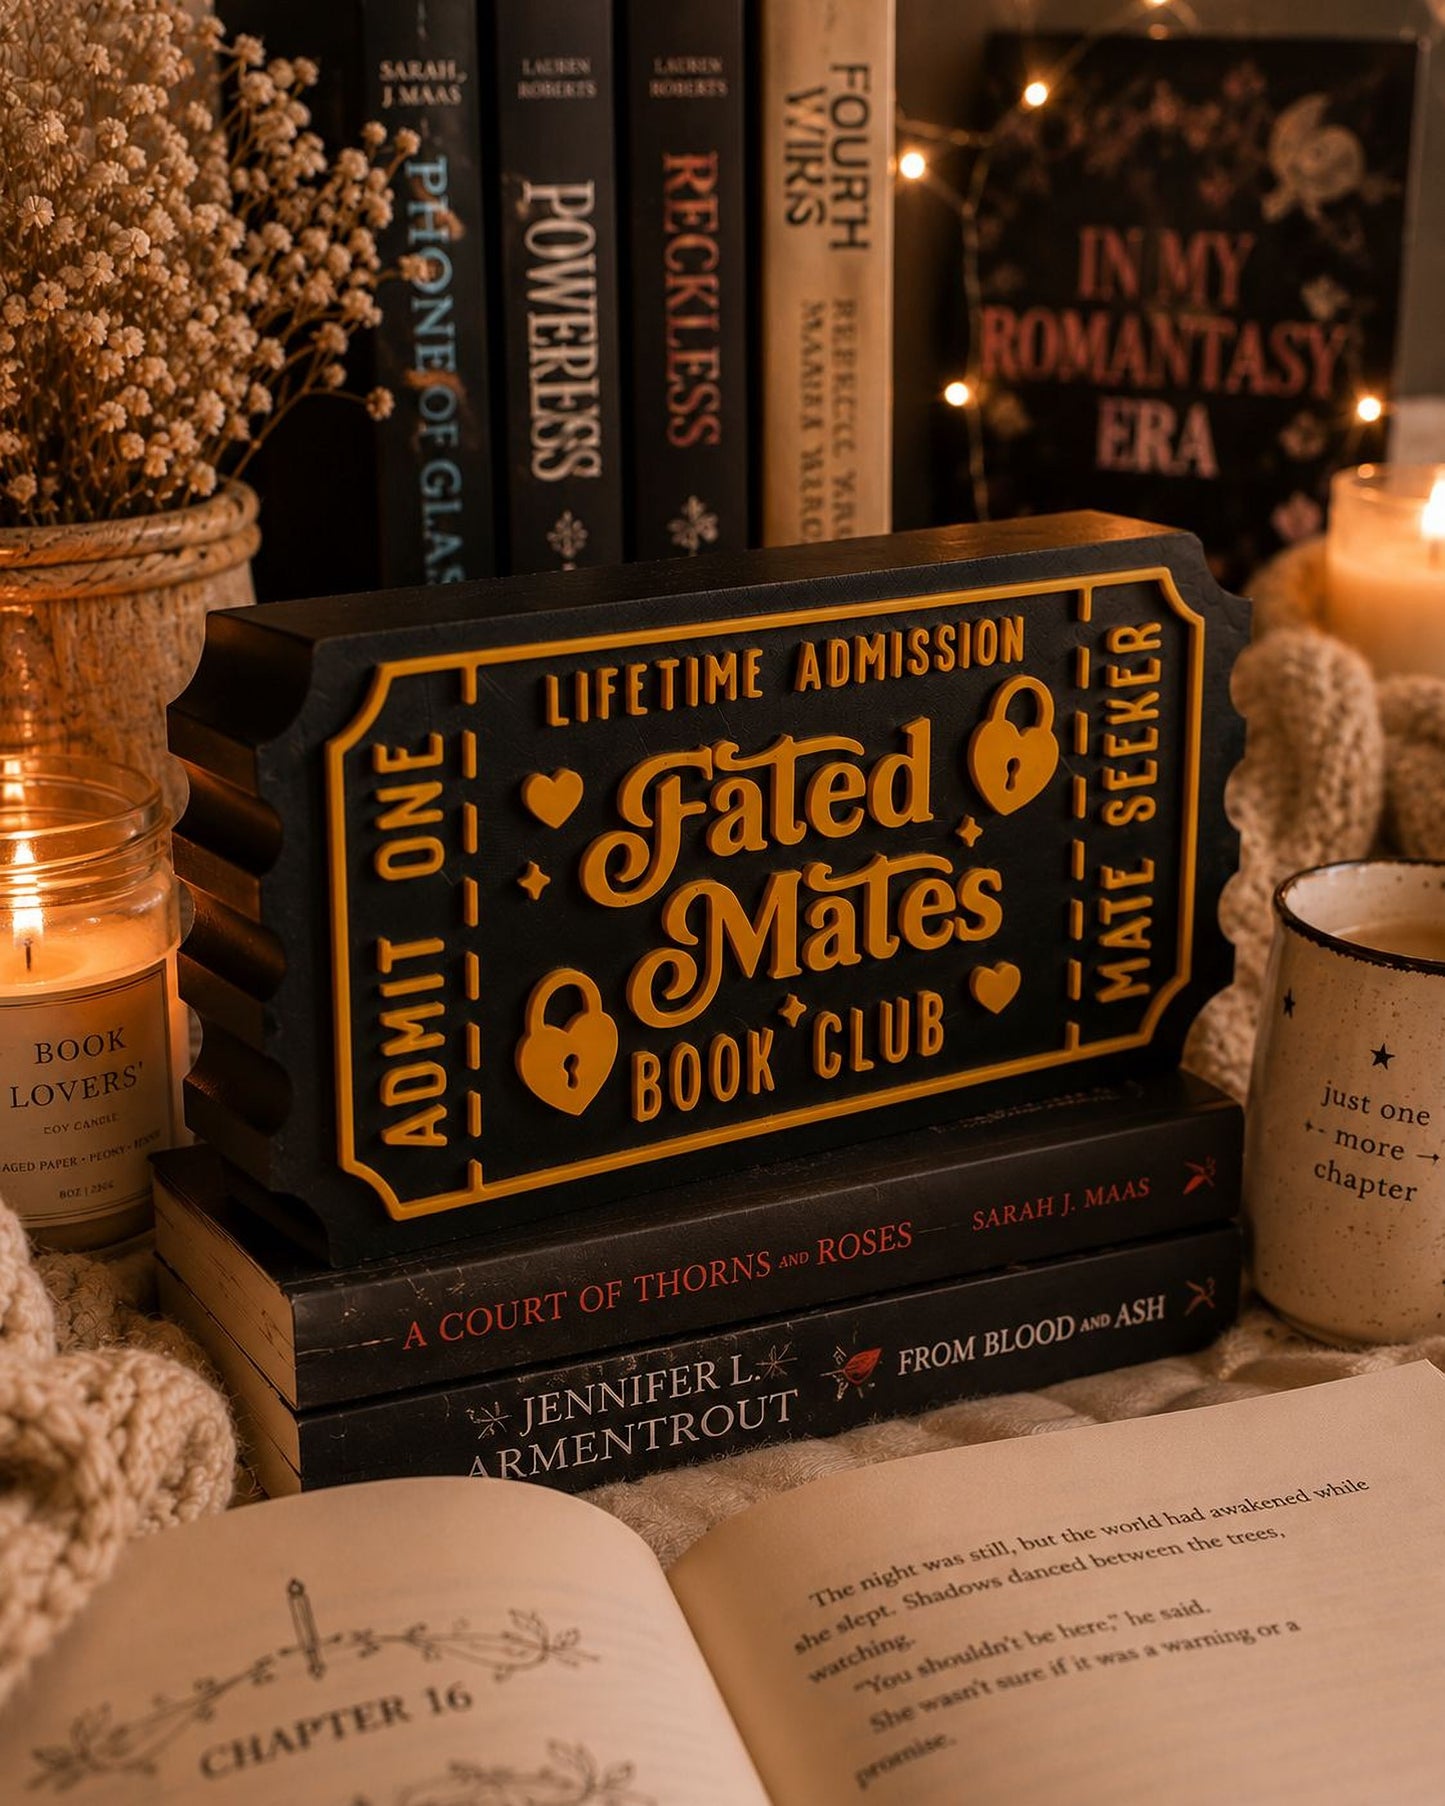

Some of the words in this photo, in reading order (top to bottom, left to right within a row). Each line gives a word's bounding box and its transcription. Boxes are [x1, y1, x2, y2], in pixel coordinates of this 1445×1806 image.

[829, 63, 871, 251] FOURTH
[663, 150, 721, 448] RECKLESS
[1078, 226, 1144, 299] IN
[1157, 231, 1257, 307] MY
[981, 305, 1348, 398] ROMANTASY
[418, 386, 459, 448] OF
[1098, 401, 1220, 478] ERA
[546, 648, 764, 727] LIFETIME
[795, 616, 1024, 692] ADMISSION
[1102, 621, 1162, 826] SEEKER
[372, 731, 444, 882] ONE
[579, 716, 934, 908] Fated
[627, 853, 1003, 1029] Mates
[1096, 858, 1154, 1003] MATE
[10, 1061, 144, 1109] LOVERS'
[35, 1027, 127, 1065] BOOK
[377, 937, 448, 1147] ADMIT
[631, 1027, 775, 1122] BOOK
[813, 990, 944, 1079] CLUB
[1321, 1080, 1371, 1114] just
[1380, 1103, 1430, 1126] one
[1335, 1128, 1405, 1160] more
[2, 1161, 35, 1172] AGED
[40, 1157, 77, 1171] PAPER
[972, 1196, 1054, 1231] SARAH
[1062, 1192, 1076, 1216] J.
[1084, 1177, 1151, 1208] MAAS
[1314, 1160, 1418, 1202] chapter
[402, 1320, 427, 1350] A
[439, 1291, 568, 1343] COURT
[579, 1279, 624, 1313] OF
[634, 1251, 771, 1304] THORNS
[778, 1249, 809, 1269] AND
[816, 1221, 913, 1265] ROSES
[898, 1335, 975, 1375] FROM
[983, 1315, 1075, 1359] BLOOD
[1079, 1313, 1110, 1333] AND
[1114, 1295, 1165, 1329] ASH
[468, 1388, 799, 1481] ARMENTROUT
[520, 1359, 720, 1436] JENNIFER
[730, 1353, 762, 1386] L.
[793, 1627, 832, 1655] she
[836, 1604, 897, 1635] slept.
[901, 1574, 1003, 1611] Shadows
[1007, 1554, 1088, 1585] danced
[1089, 1543, 1184, 1569] between
[1187, 1533, 1223, 1552] the
[1225, 1525, 1286, 1545] trees,
[808, 1582, 856, 1609] The
[860, 1565, 918, 1588] night
[922, 1552, 965, 1572] was
[969, 1540, 1017, 1563] still,
[1017, 1533, 1059, 1552] but
[1061, 1524, 1097, 1544] the
[1100, 1514, 1163, 1536] world
[1162, 1507, 1206, 1527] had
[1209, 1488, 1312, 1519] awakened
[1312, 1478, 1370, 1501] while
[807, 1633, 916, 1684] watching.
[869, 1704, 916, 1733] She
[918, 1676, 993, 1714] wasn't
[995, 1666, 1047, 1691] sure
[1049, 1659, 1069, 1679] if
[1073, 1654, 1092, 1673] it
[1095, 1646, 1140, 1668] was
[1145, 1644, 1158, 1658] a
[1160, 1628, 1257, 1655] warning
[1256, 1622, 1281, 1638] or
[1285, 1619, 1301, 1633] a
[916, 1635, 1024, 1678] shouldn't
[1024, 1630, 1055, 1647] be
[1124, 1610, 1157, 1628] he
[1159, 1598, 1212, 1620] said.
[200, 1694, 412, 1782] CHAPTER
[423, 1680, 474, 1716] 16
